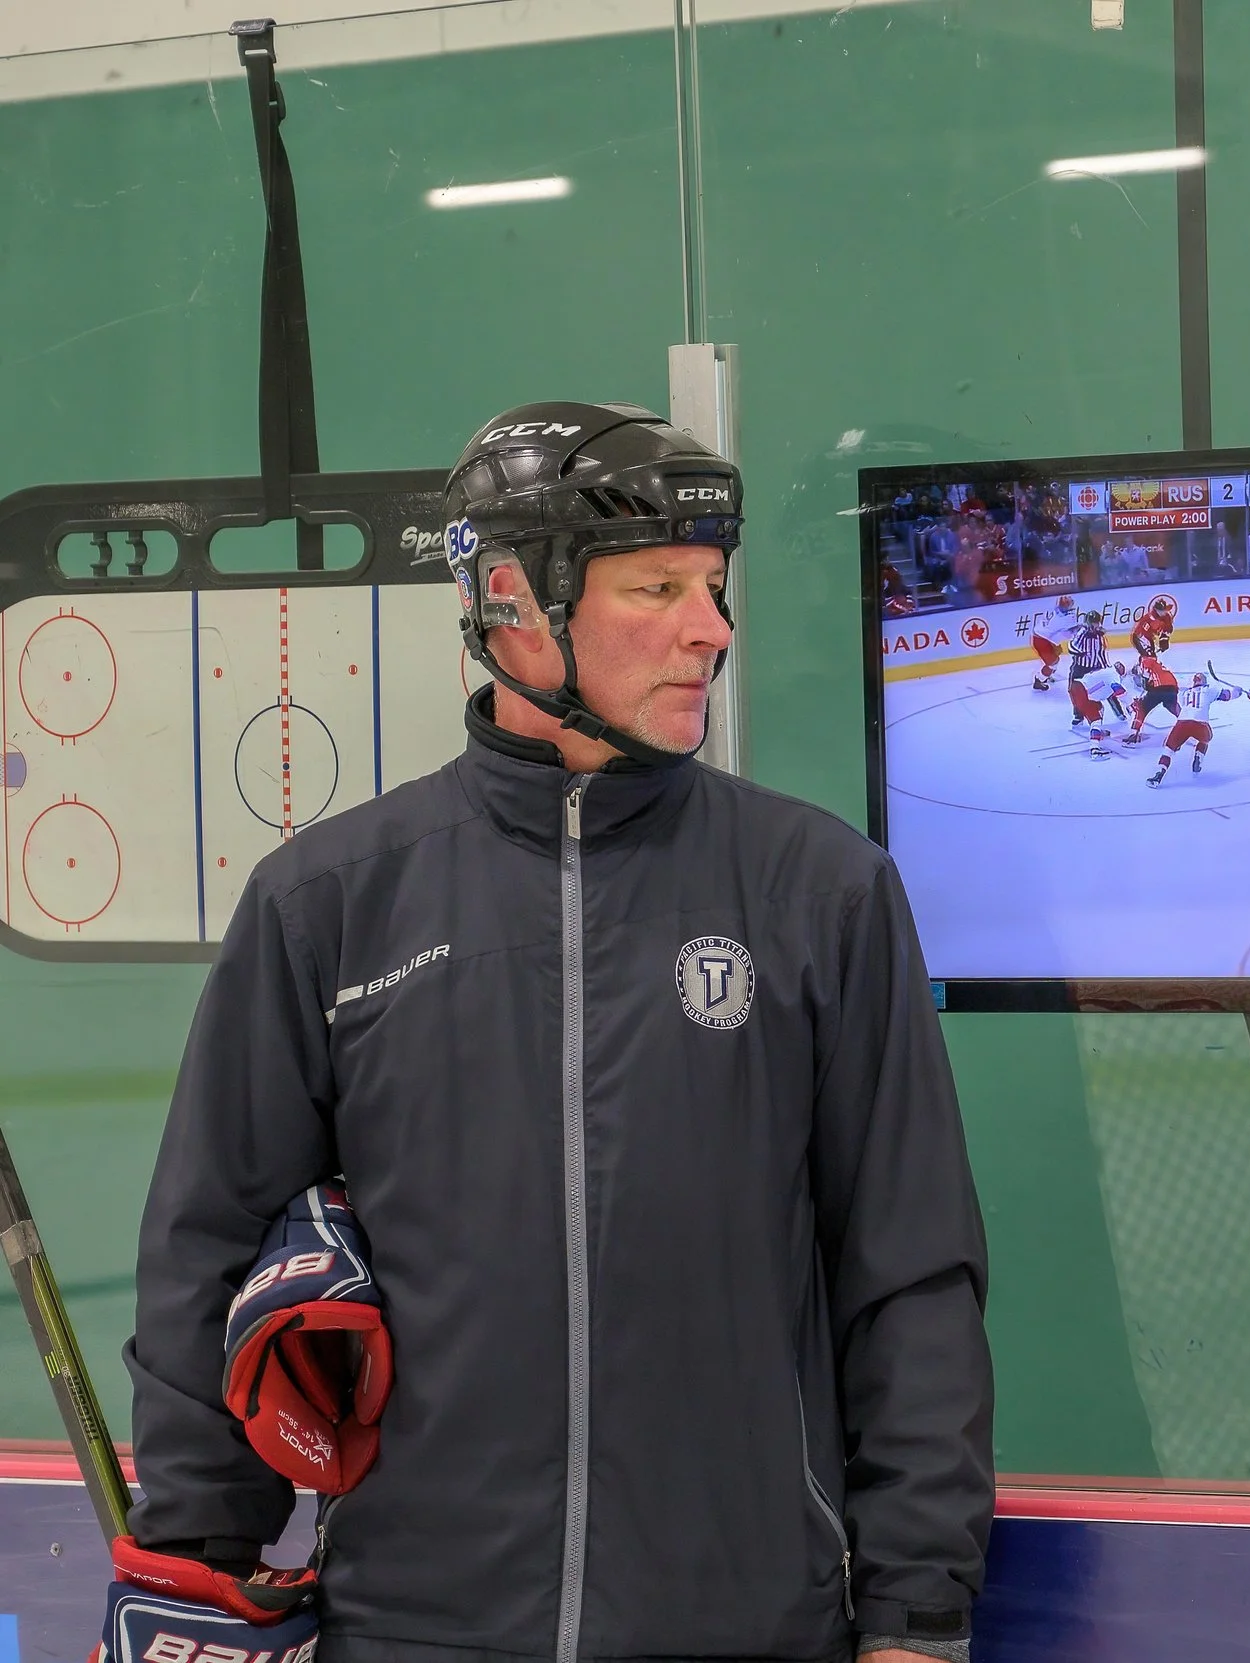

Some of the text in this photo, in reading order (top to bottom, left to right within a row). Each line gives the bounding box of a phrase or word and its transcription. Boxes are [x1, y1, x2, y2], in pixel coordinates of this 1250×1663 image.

[481, 422, 582, 445] CCM
[676, 487, 729, 501] CCM
[1167, 485, 1204, 502] RUS
[1223, 483, 1234, 500] 2
[1114, 511, 1207, 527] POWER PLAY 2:00
[448, 519, 477, 563] BC
[681, 939, 751, 967] PACIFIC TITANS
[682, 997, 751, 1027] HOCKEY PROGRAM
[278, 1409, 299, 1430] 36cm
[278, 1422, 325, 1472] VAPOR
[130, 1571, 179, 1586] VAPOR
